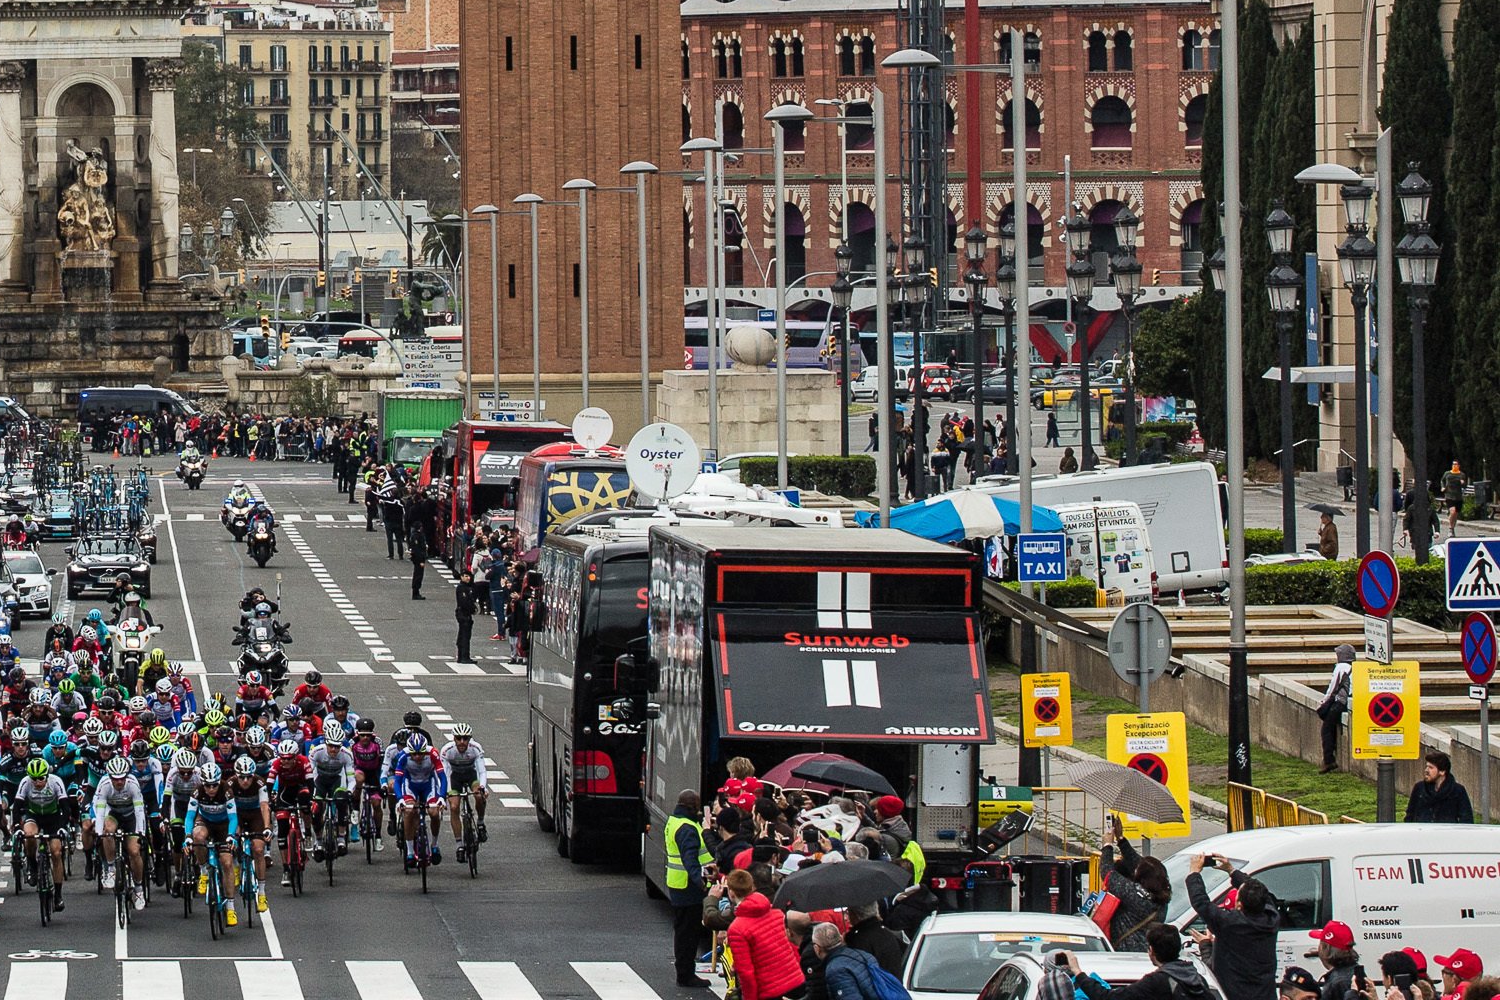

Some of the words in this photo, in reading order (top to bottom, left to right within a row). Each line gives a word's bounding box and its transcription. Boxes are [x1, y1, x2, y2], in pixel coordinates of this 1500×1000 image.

[639, 448, 684, 462] Oyster
[1065, 513, 1082, 522] TOUS
[1082, 512, 1094, 520] LES
[1096, 510, 1130, 519] MAILLOTS
[1078, 521, 1095, 529] PROS
[1099, 519, 1108, 527] ET
[1108, 517, 1137, 526] VINTAGE
[1023, 562, 1062, 575] TAXI
[783, 631, 910, 648] Sunweb
[799, 646, 896, 654] #CREATINGMEMORIES
[756, 724, 830, 734] GIANT
[1123, 721, 1171, 730] Senyalització
[902, 726, 977, 736] RENSON
[1125, 730, 1169, 738] Excepcional
[1355, 866, 1405, 881] TEAM
[1428, 861, 1500, 879] Sunwe
[1368, 905, 1400, 913] GIANT
[1363, 932, 1403, 940] SAMSUNG
